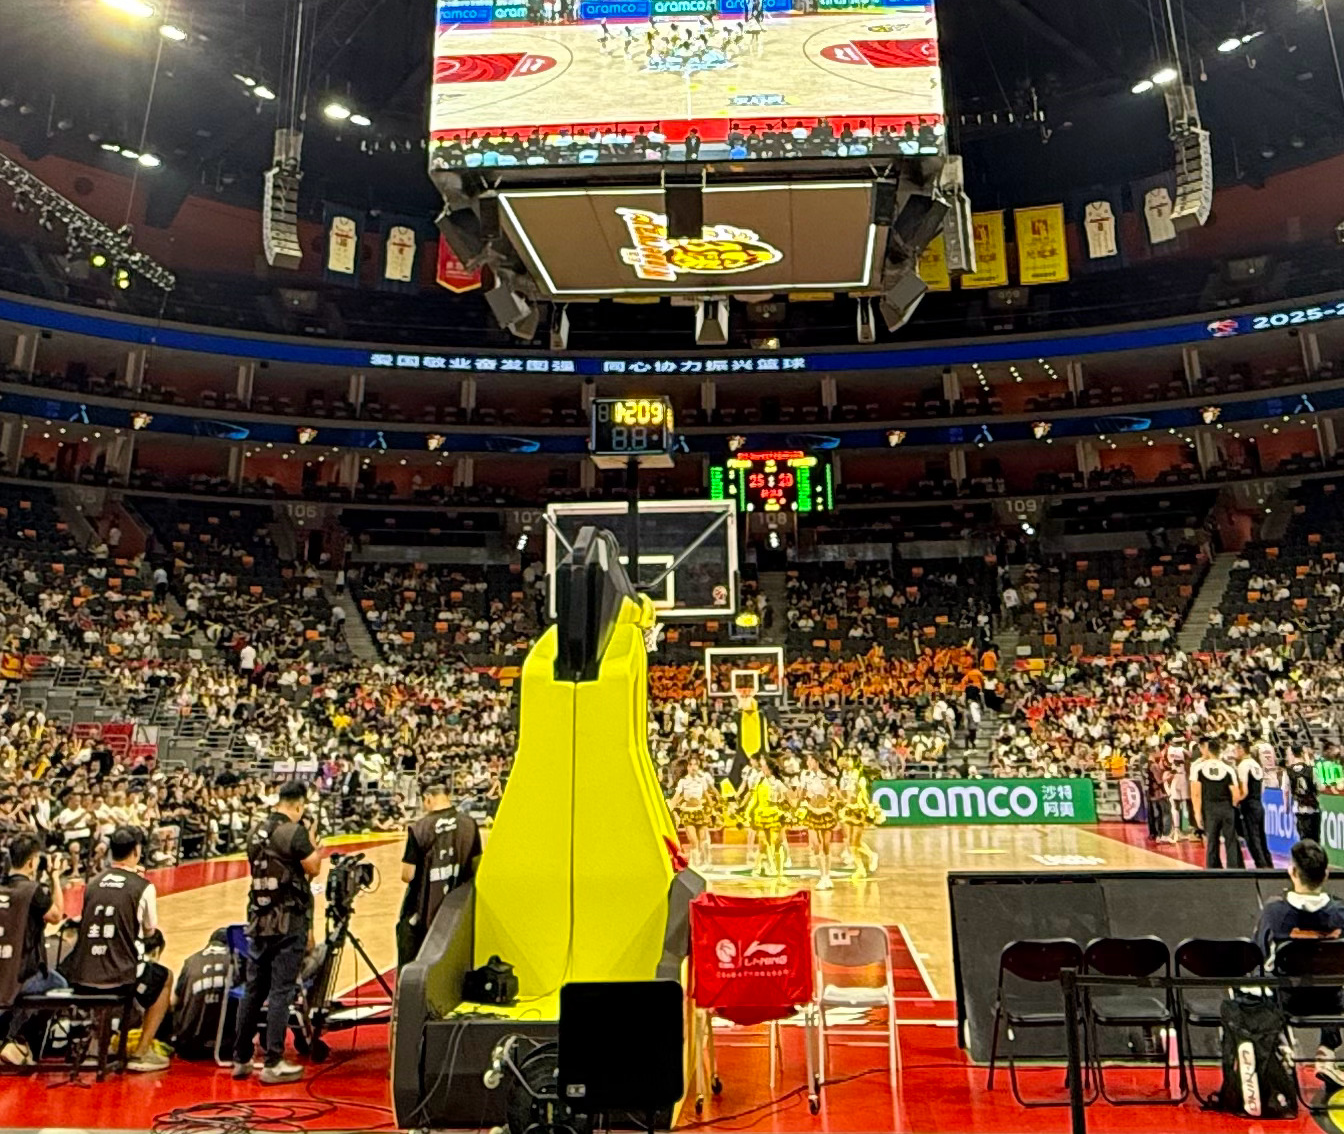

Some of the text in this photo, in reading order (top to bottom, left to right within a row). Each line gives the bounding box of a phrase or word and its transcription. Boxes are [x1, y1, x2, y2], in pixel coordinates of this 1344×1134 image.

[586, 2, 637, 14] aramco
[603, 357, 805, 373] 同心协力振兴篮球
[287, 504, 317, 518] 106
[1006, 499, 1037, 513] 109
[513, 510, 543, 524] 107
[757, 512, 787, 525] 108
[1041, 784, 1073, 801] 沙特
[873, 785, 1038, 818] aramco
[1043, 801, 1075, 818] 阿美
